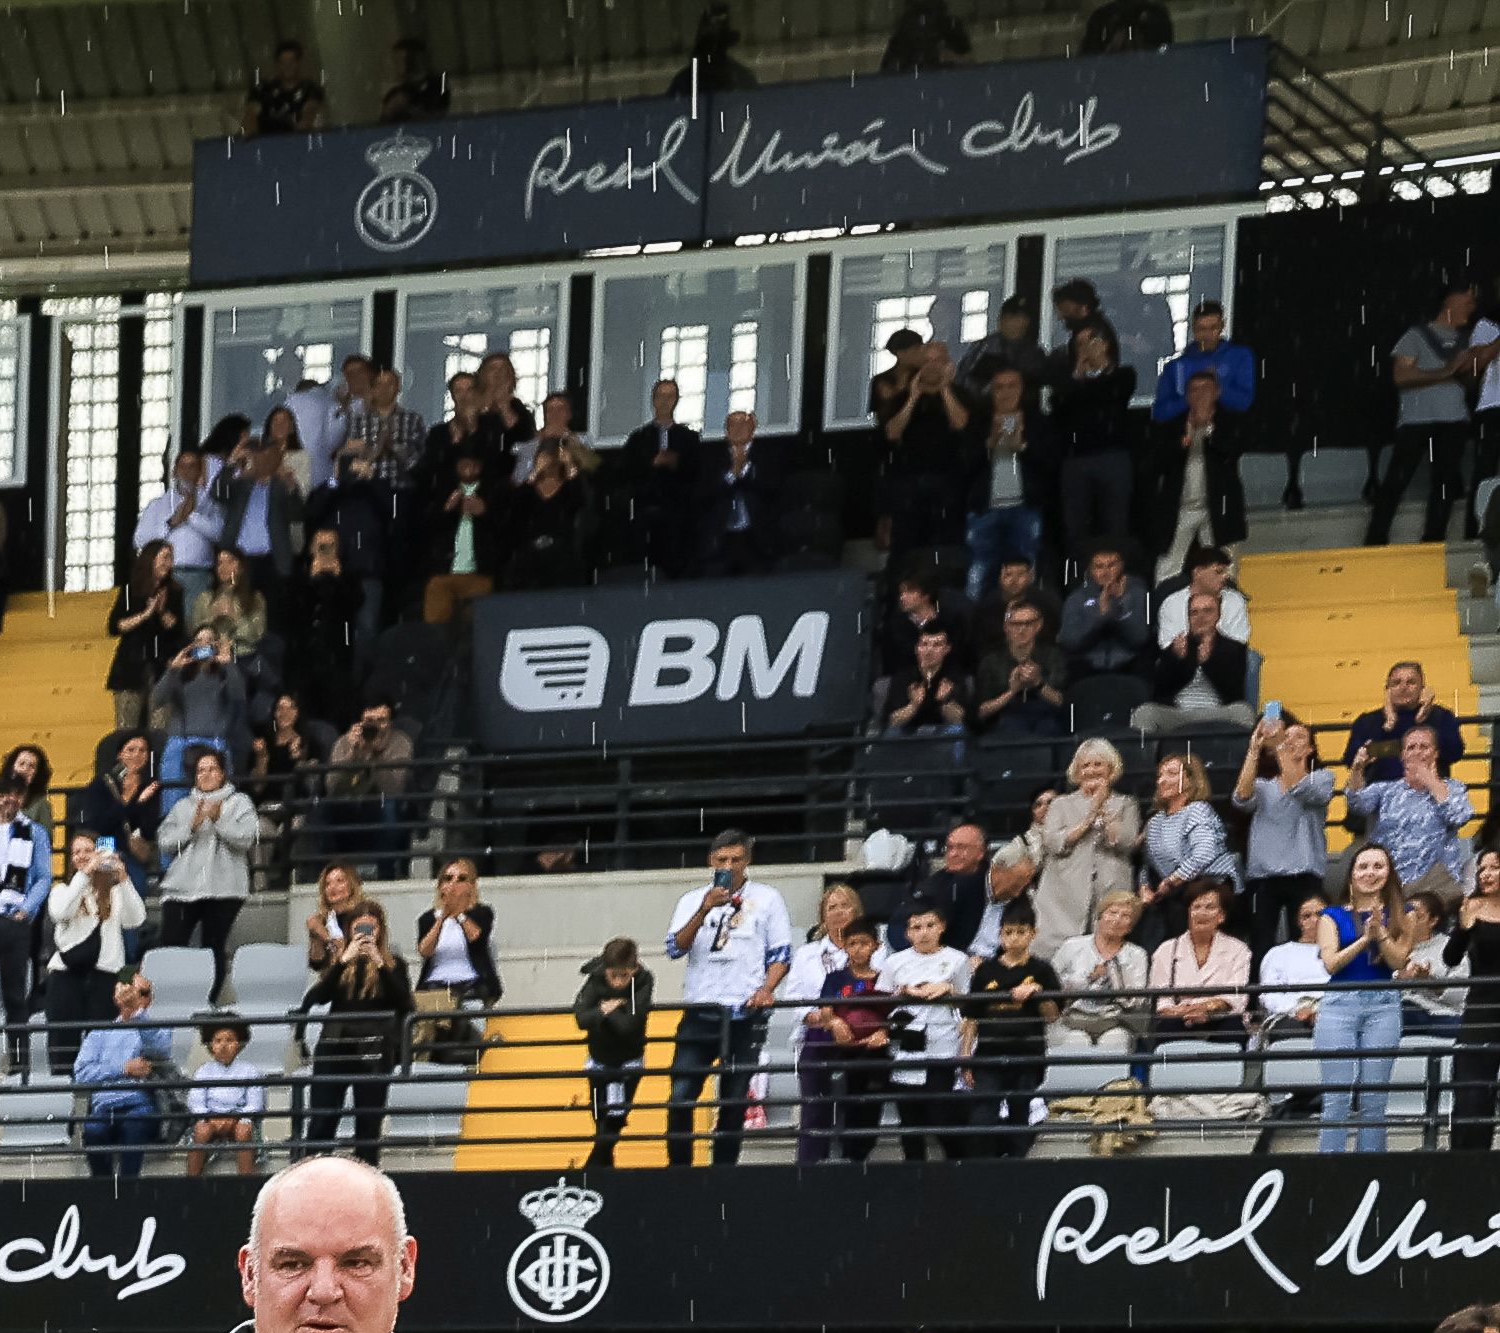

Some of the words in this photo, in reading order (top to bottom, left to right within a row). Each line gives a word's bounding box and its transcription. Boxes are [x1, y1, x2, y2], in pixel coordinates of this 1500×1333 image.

[524, 116, 700, 221] Real
[709, 118, 949, 188] Unión
[627, 610, 831, 707] BM
[1036, 1168, 1300, 1300] Real
